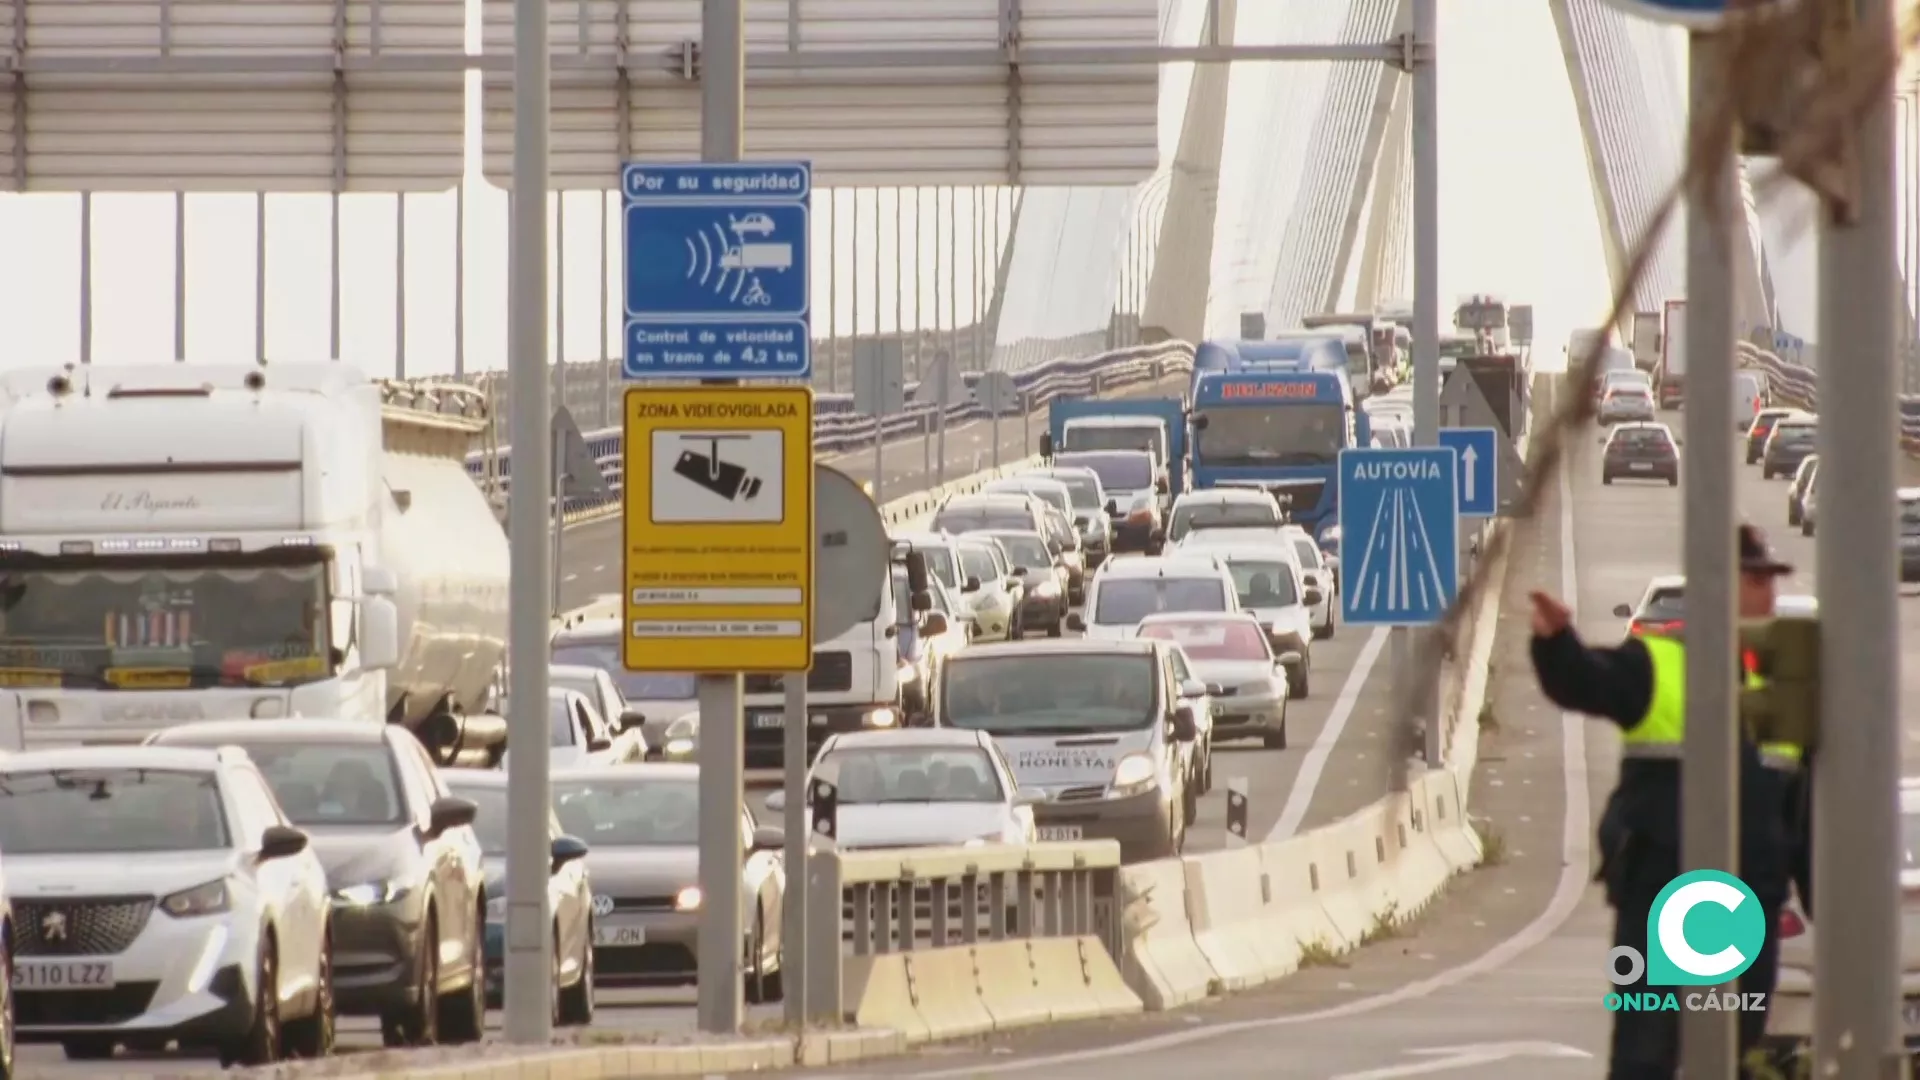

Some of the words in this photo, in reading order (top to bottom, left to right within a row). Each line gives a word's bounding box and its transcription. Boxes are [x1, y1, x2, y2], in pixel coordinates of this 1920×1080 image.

[632, 173, 664, 190] Por
[678, 176, 698, 189] su
[712, 173, 800, 192] seguridad
[636, 329, 690, 343] Control
[699, 330, 716, 342] de
[727, 329, 794, 343] velocidad
[636, 353, 654, 364] en
[664, 351, 704, 364] tramo
[714, 351, 731, 364] de
[777, 351, 798, 363] km
[638, 404, 679, 418] ZONA
[684, 404, 797, 418] VIDEOVIGILADA
[1353, 457, 1441, 480] AUTOVÍA
[1019, 758, 1116, 769] HONESTAS
[68, 964, 106, 985] LZZ
